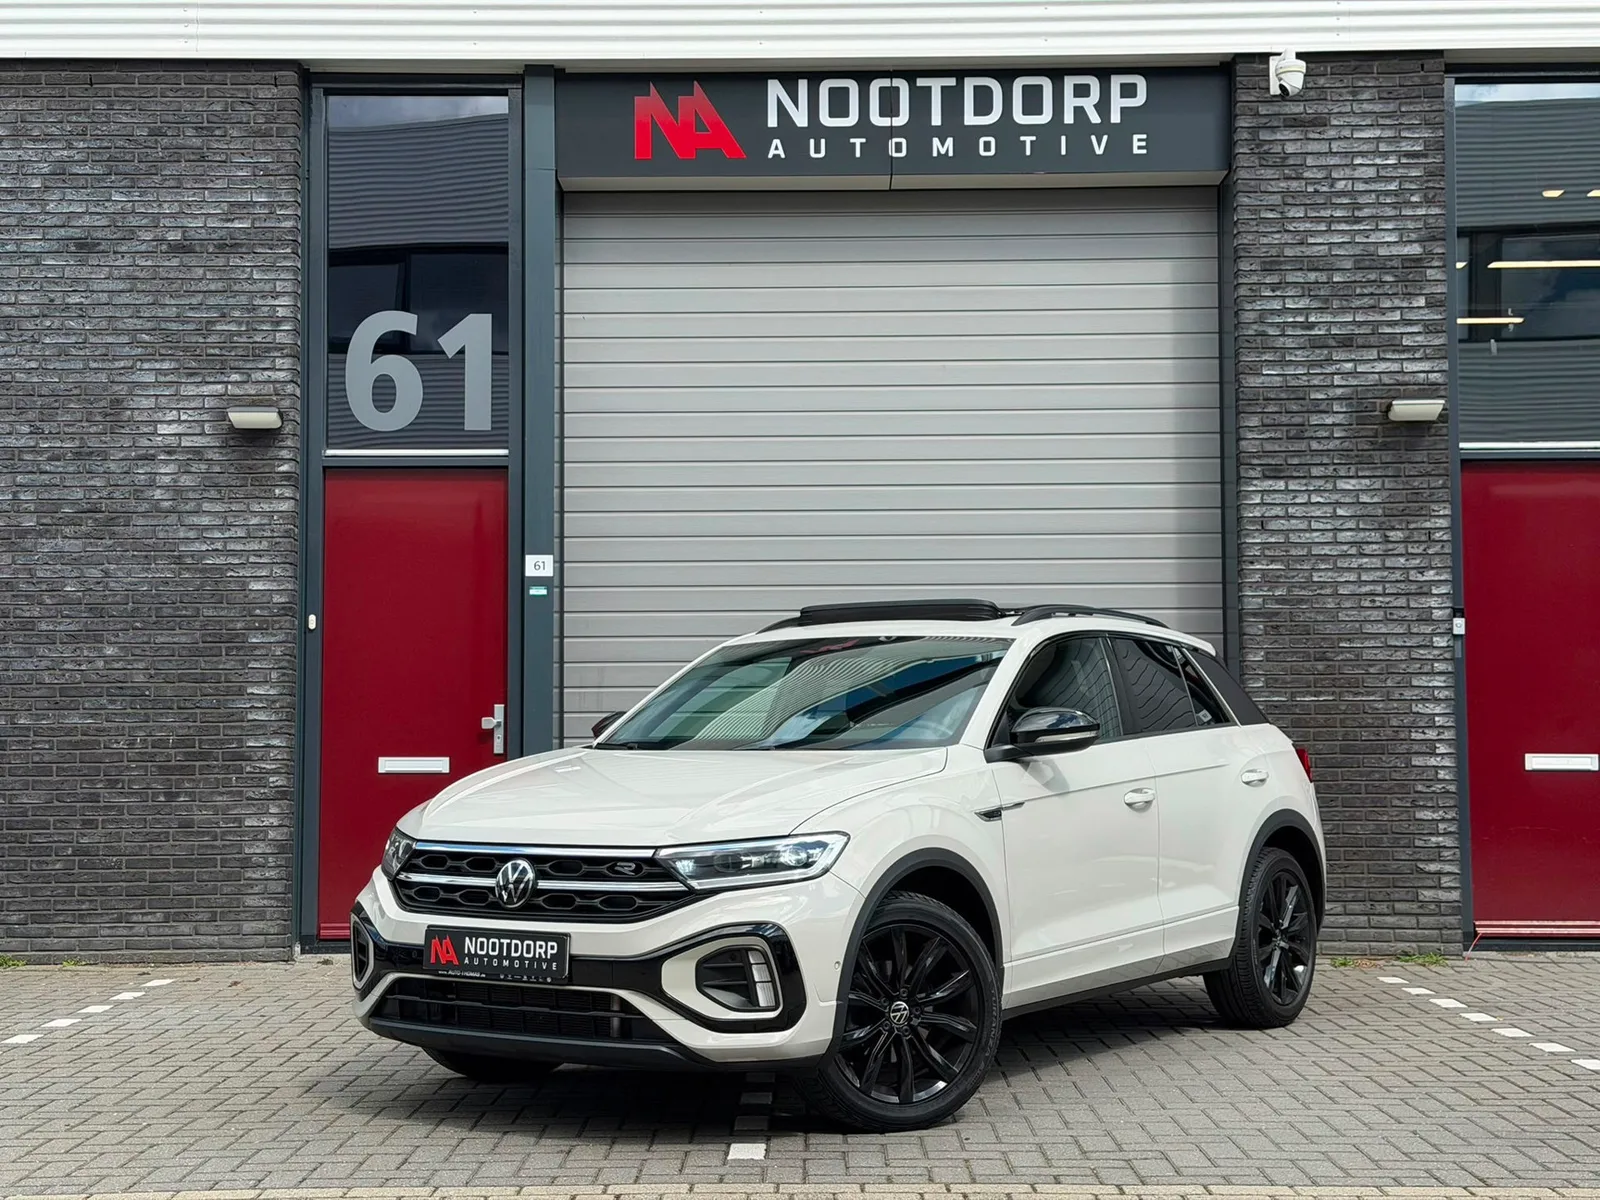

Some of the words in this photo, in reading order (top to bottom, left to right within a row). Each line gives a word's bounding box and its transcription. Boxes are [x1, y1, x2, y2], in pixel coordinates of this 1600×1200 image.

[766, 73, 1148, 128] NOOTDORP
[766, 132, 1148, 159] AUTOMOTIVE
[345, 310, 492, 432] 61
[533, 560, 546, 571] 61
[464, 936, 558, 960] NOOTDORP
[463, 956, 558, 971] AUTOMOTIVE
